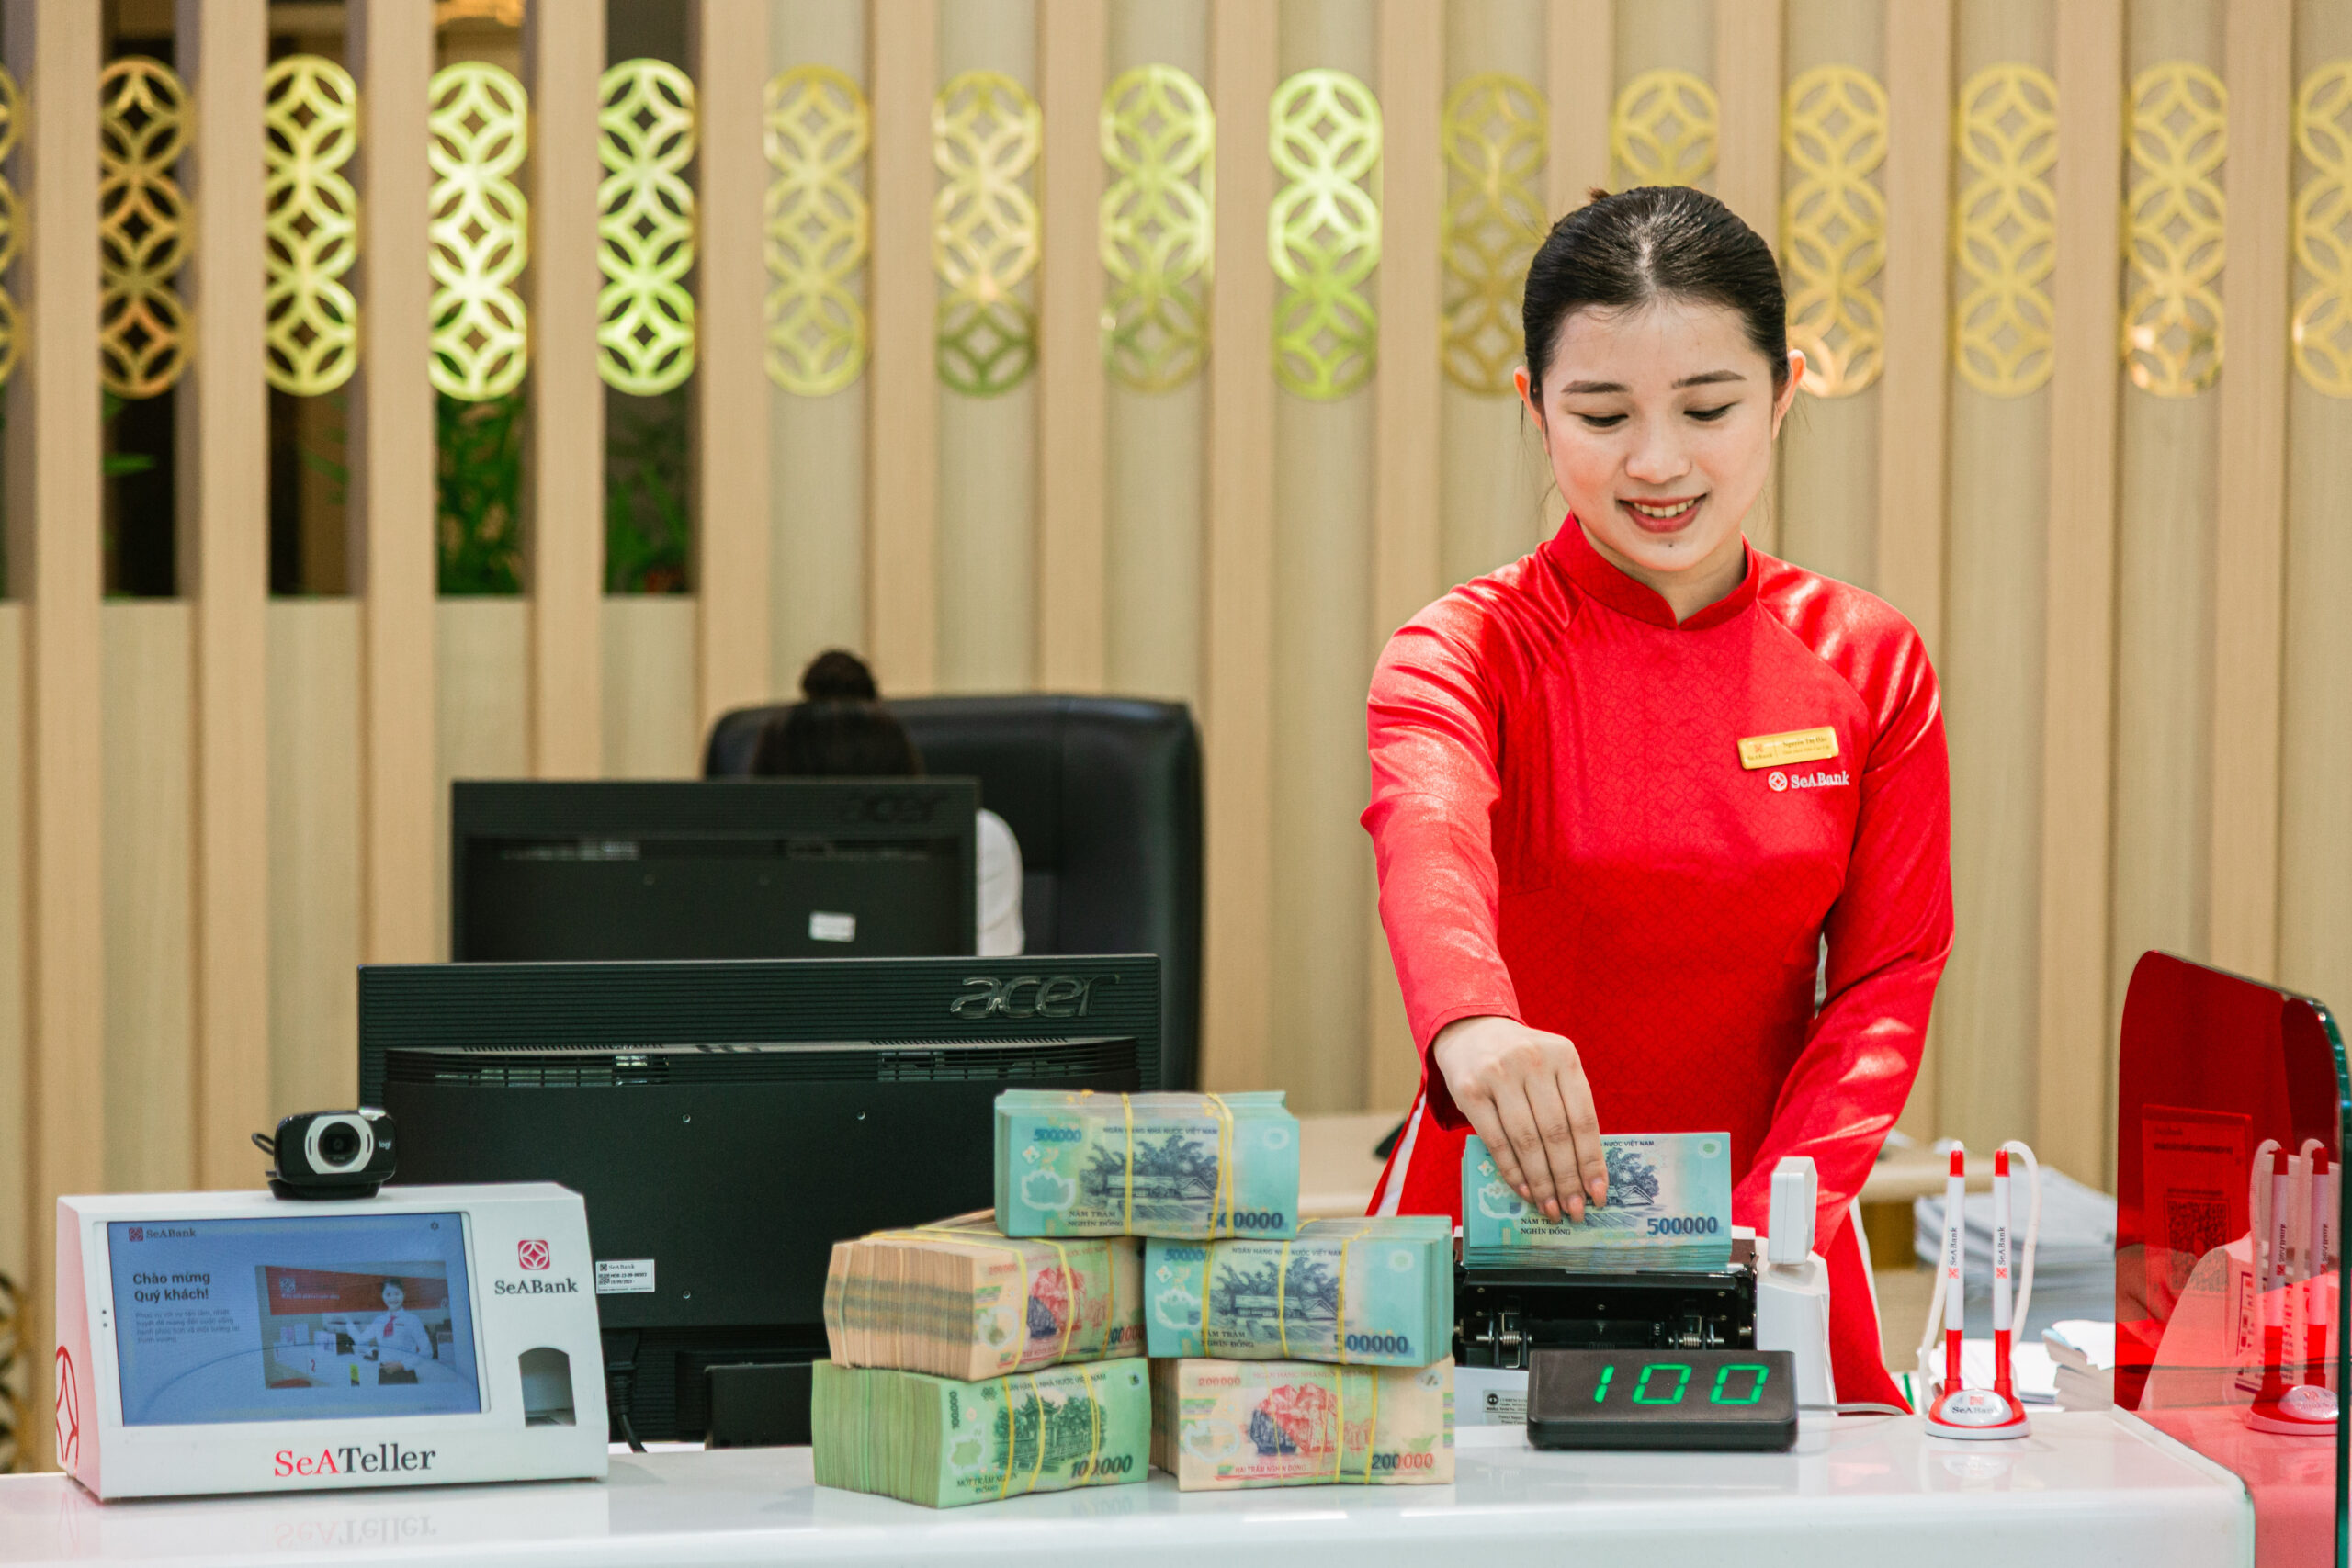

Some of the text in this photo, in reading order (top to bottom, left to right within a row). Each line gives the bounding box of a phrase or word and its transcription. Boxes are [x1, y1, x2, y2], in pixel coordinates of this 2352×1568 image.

[1791, 770, 1850, 789] SeABank
[950, 974, 1121, 1019] acer
[379, 1140, 391, 1150] logi
[145, 1228, 197, 1239] SeABank
[1647, 1216, 1718, 1235] 500000
[1950, 1227, 1958, 1266] SeABank
[1997, 1226, 2006, 1266] SeABank
[132, 1271, 211, 1285] Chào mừng
[494, 1278, 579, 1295] SeABank
[134, 1288, 209, 1304] Quý khách!
[1594, 1363, 1770, 1405] 100
[274, 1442, 436, 1478] SeATeller
[1371, 1452, 1434, 1470] 200000
